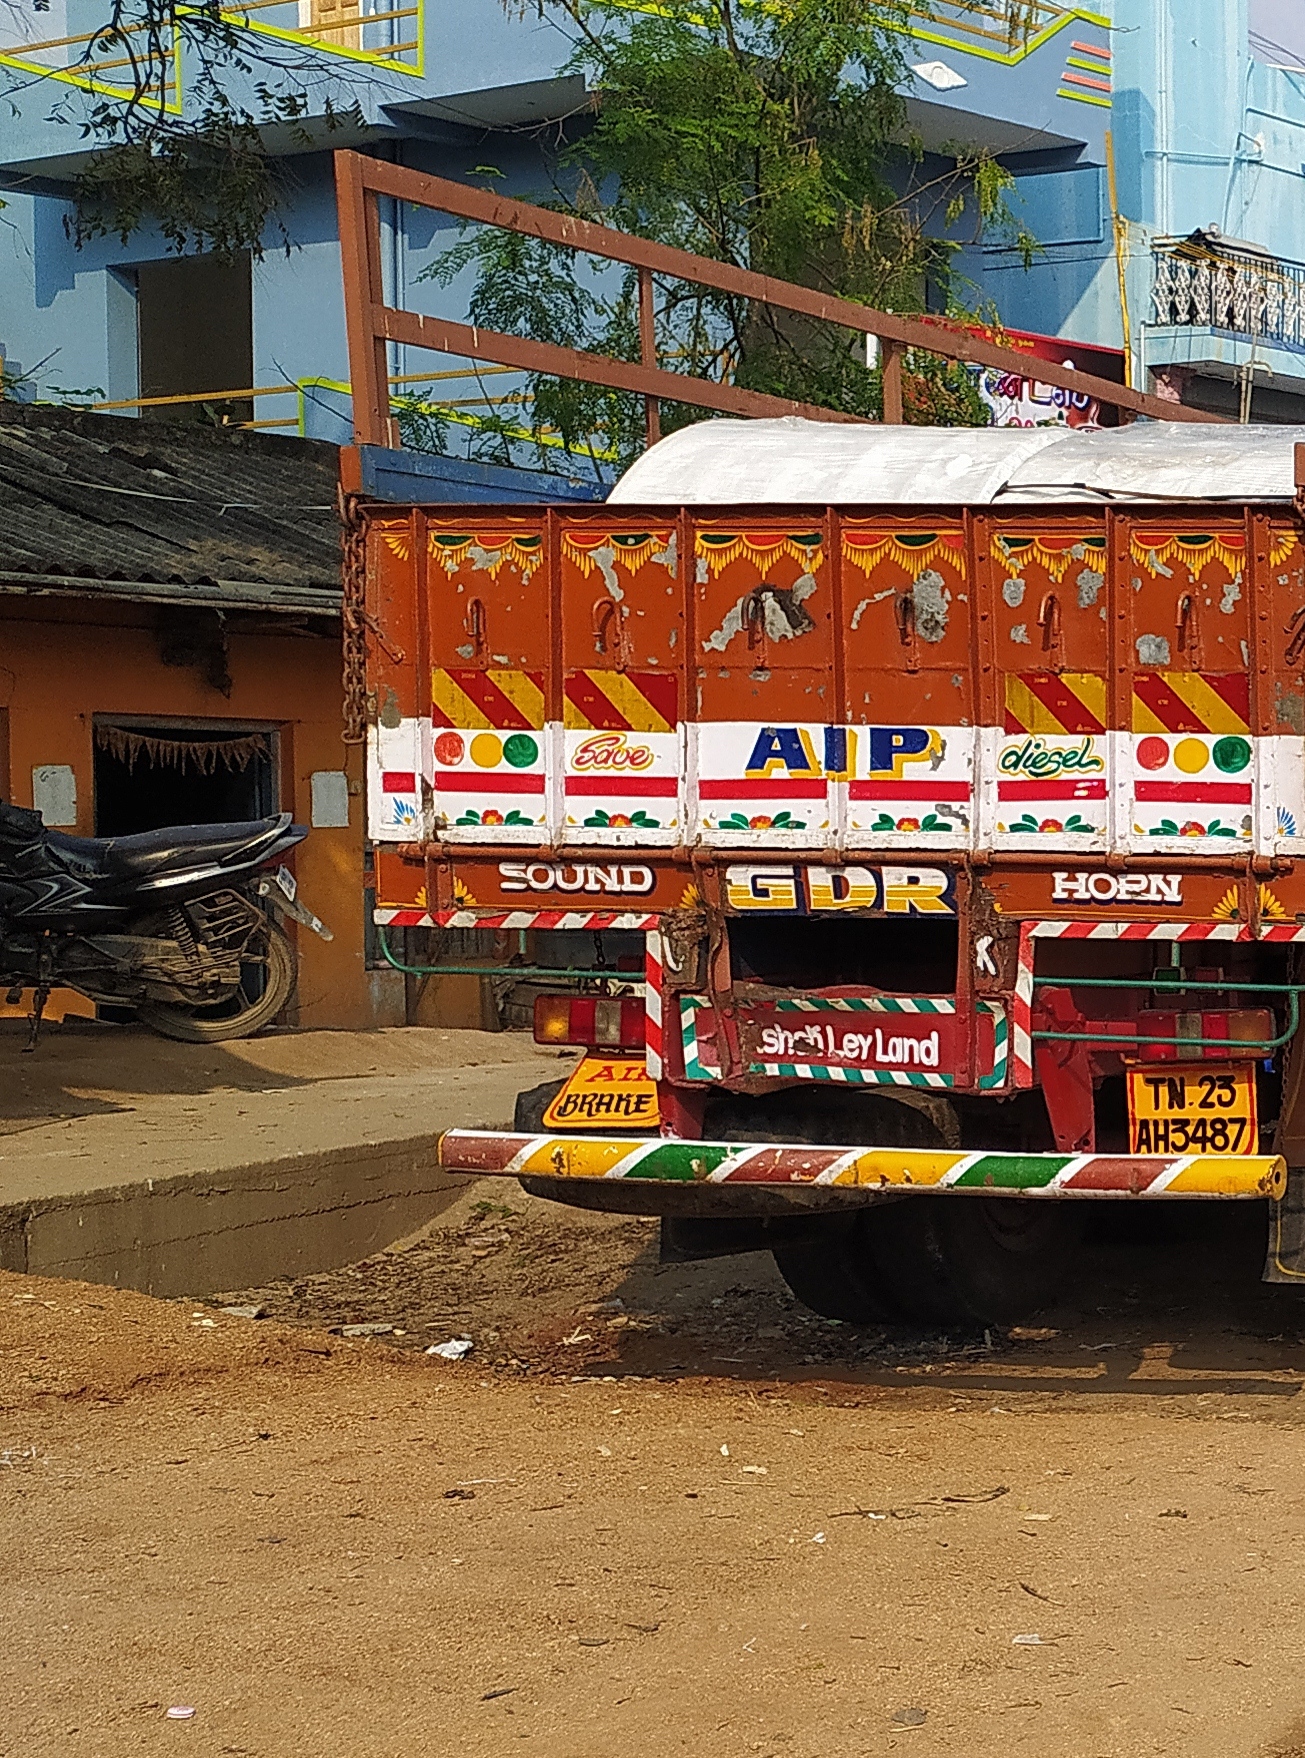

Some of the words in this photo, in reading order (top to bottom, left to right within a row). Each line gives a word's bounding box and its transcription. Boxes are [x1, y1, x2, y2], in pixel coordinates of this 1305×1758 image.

[572, 733, 654, 771] Save
[745, 727, 942, 780] AIP
[1000, 736, 1101, 777] diesel
[498, 862, 655, 895] SOUND
[727, 866, 957, 914] GDR
[556, 1092, 654, 1117] BRAKE
[1136, 1117, 1247, 1154] AH3487
